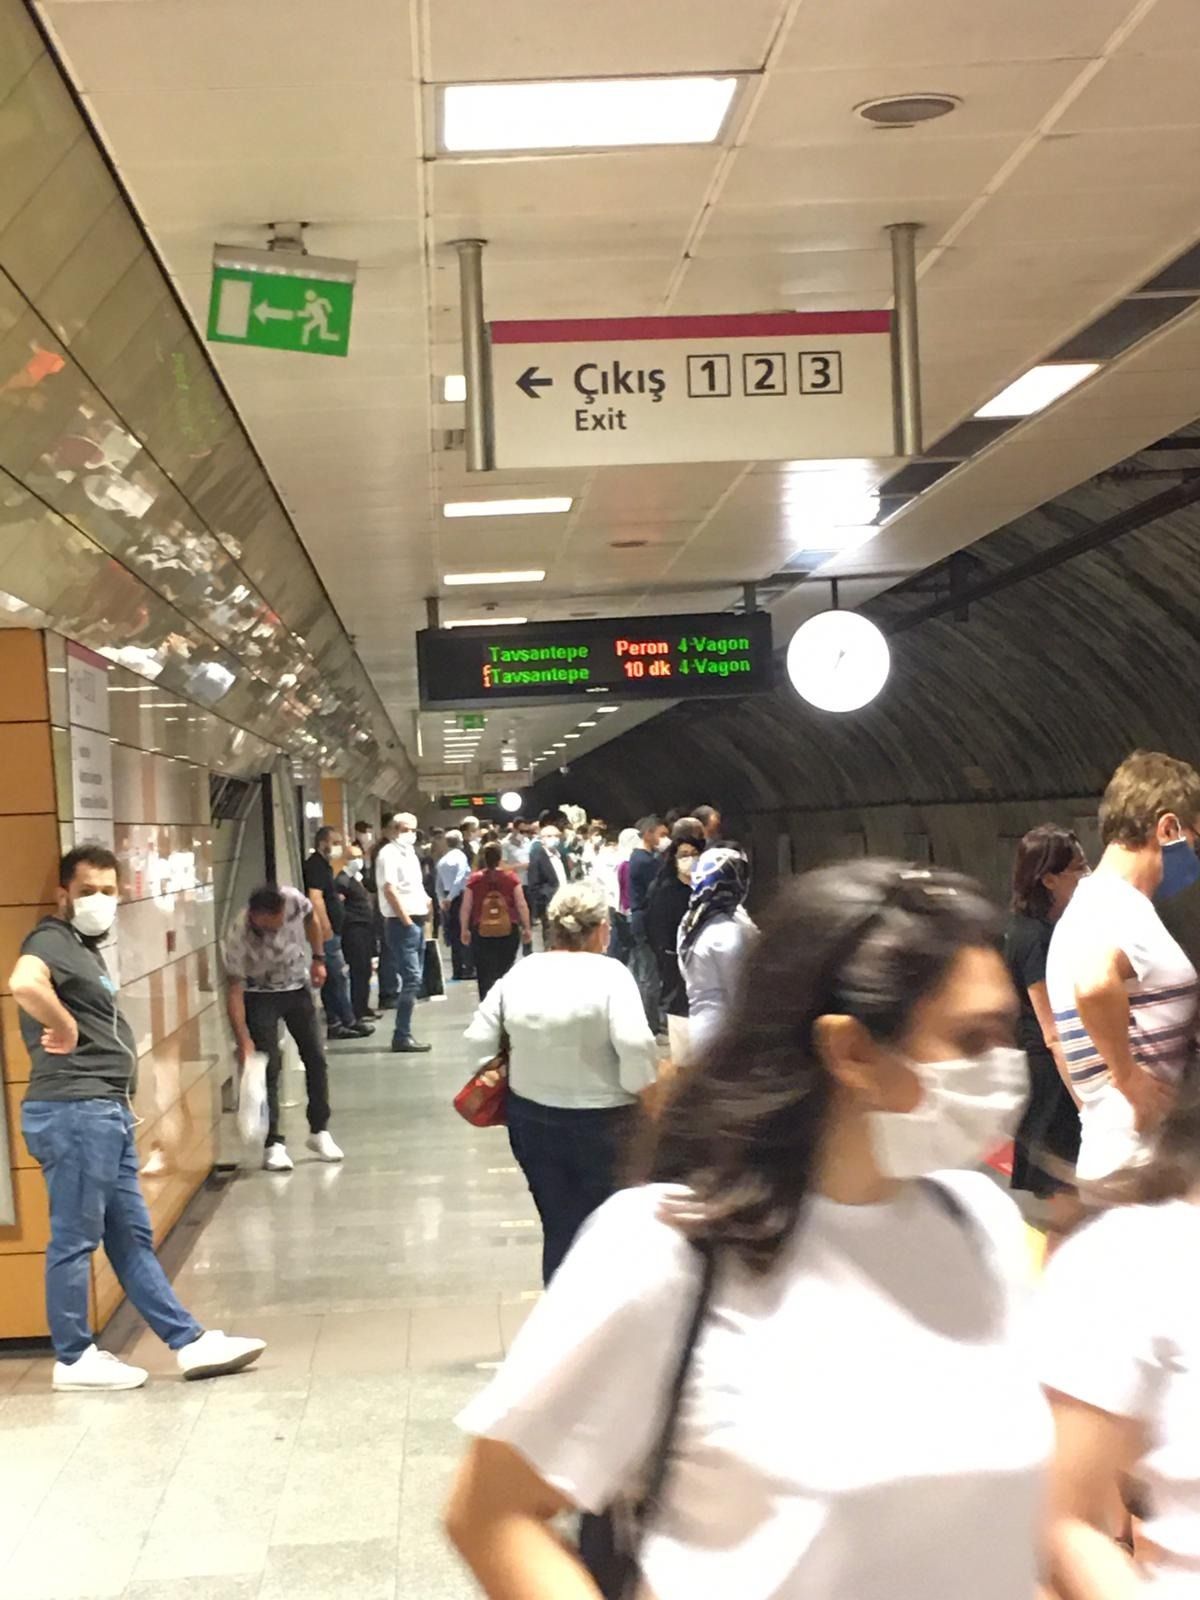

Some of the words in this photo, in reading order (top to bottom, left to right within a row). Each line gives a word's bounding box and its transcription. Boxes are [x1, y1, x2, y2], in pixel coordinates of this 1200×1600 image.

[573, 360, 666, 405] Çıkış
[700, 359, 716, 392] 1
[754, 357, 776, 391] 2
[811, 356, 831, 389] 3
[575, 407, 627, 432] Exit
[615, 638, 669, 657] Peron
[624, 661, 645, 678] 10
[648, 659, 672, 677] dk
